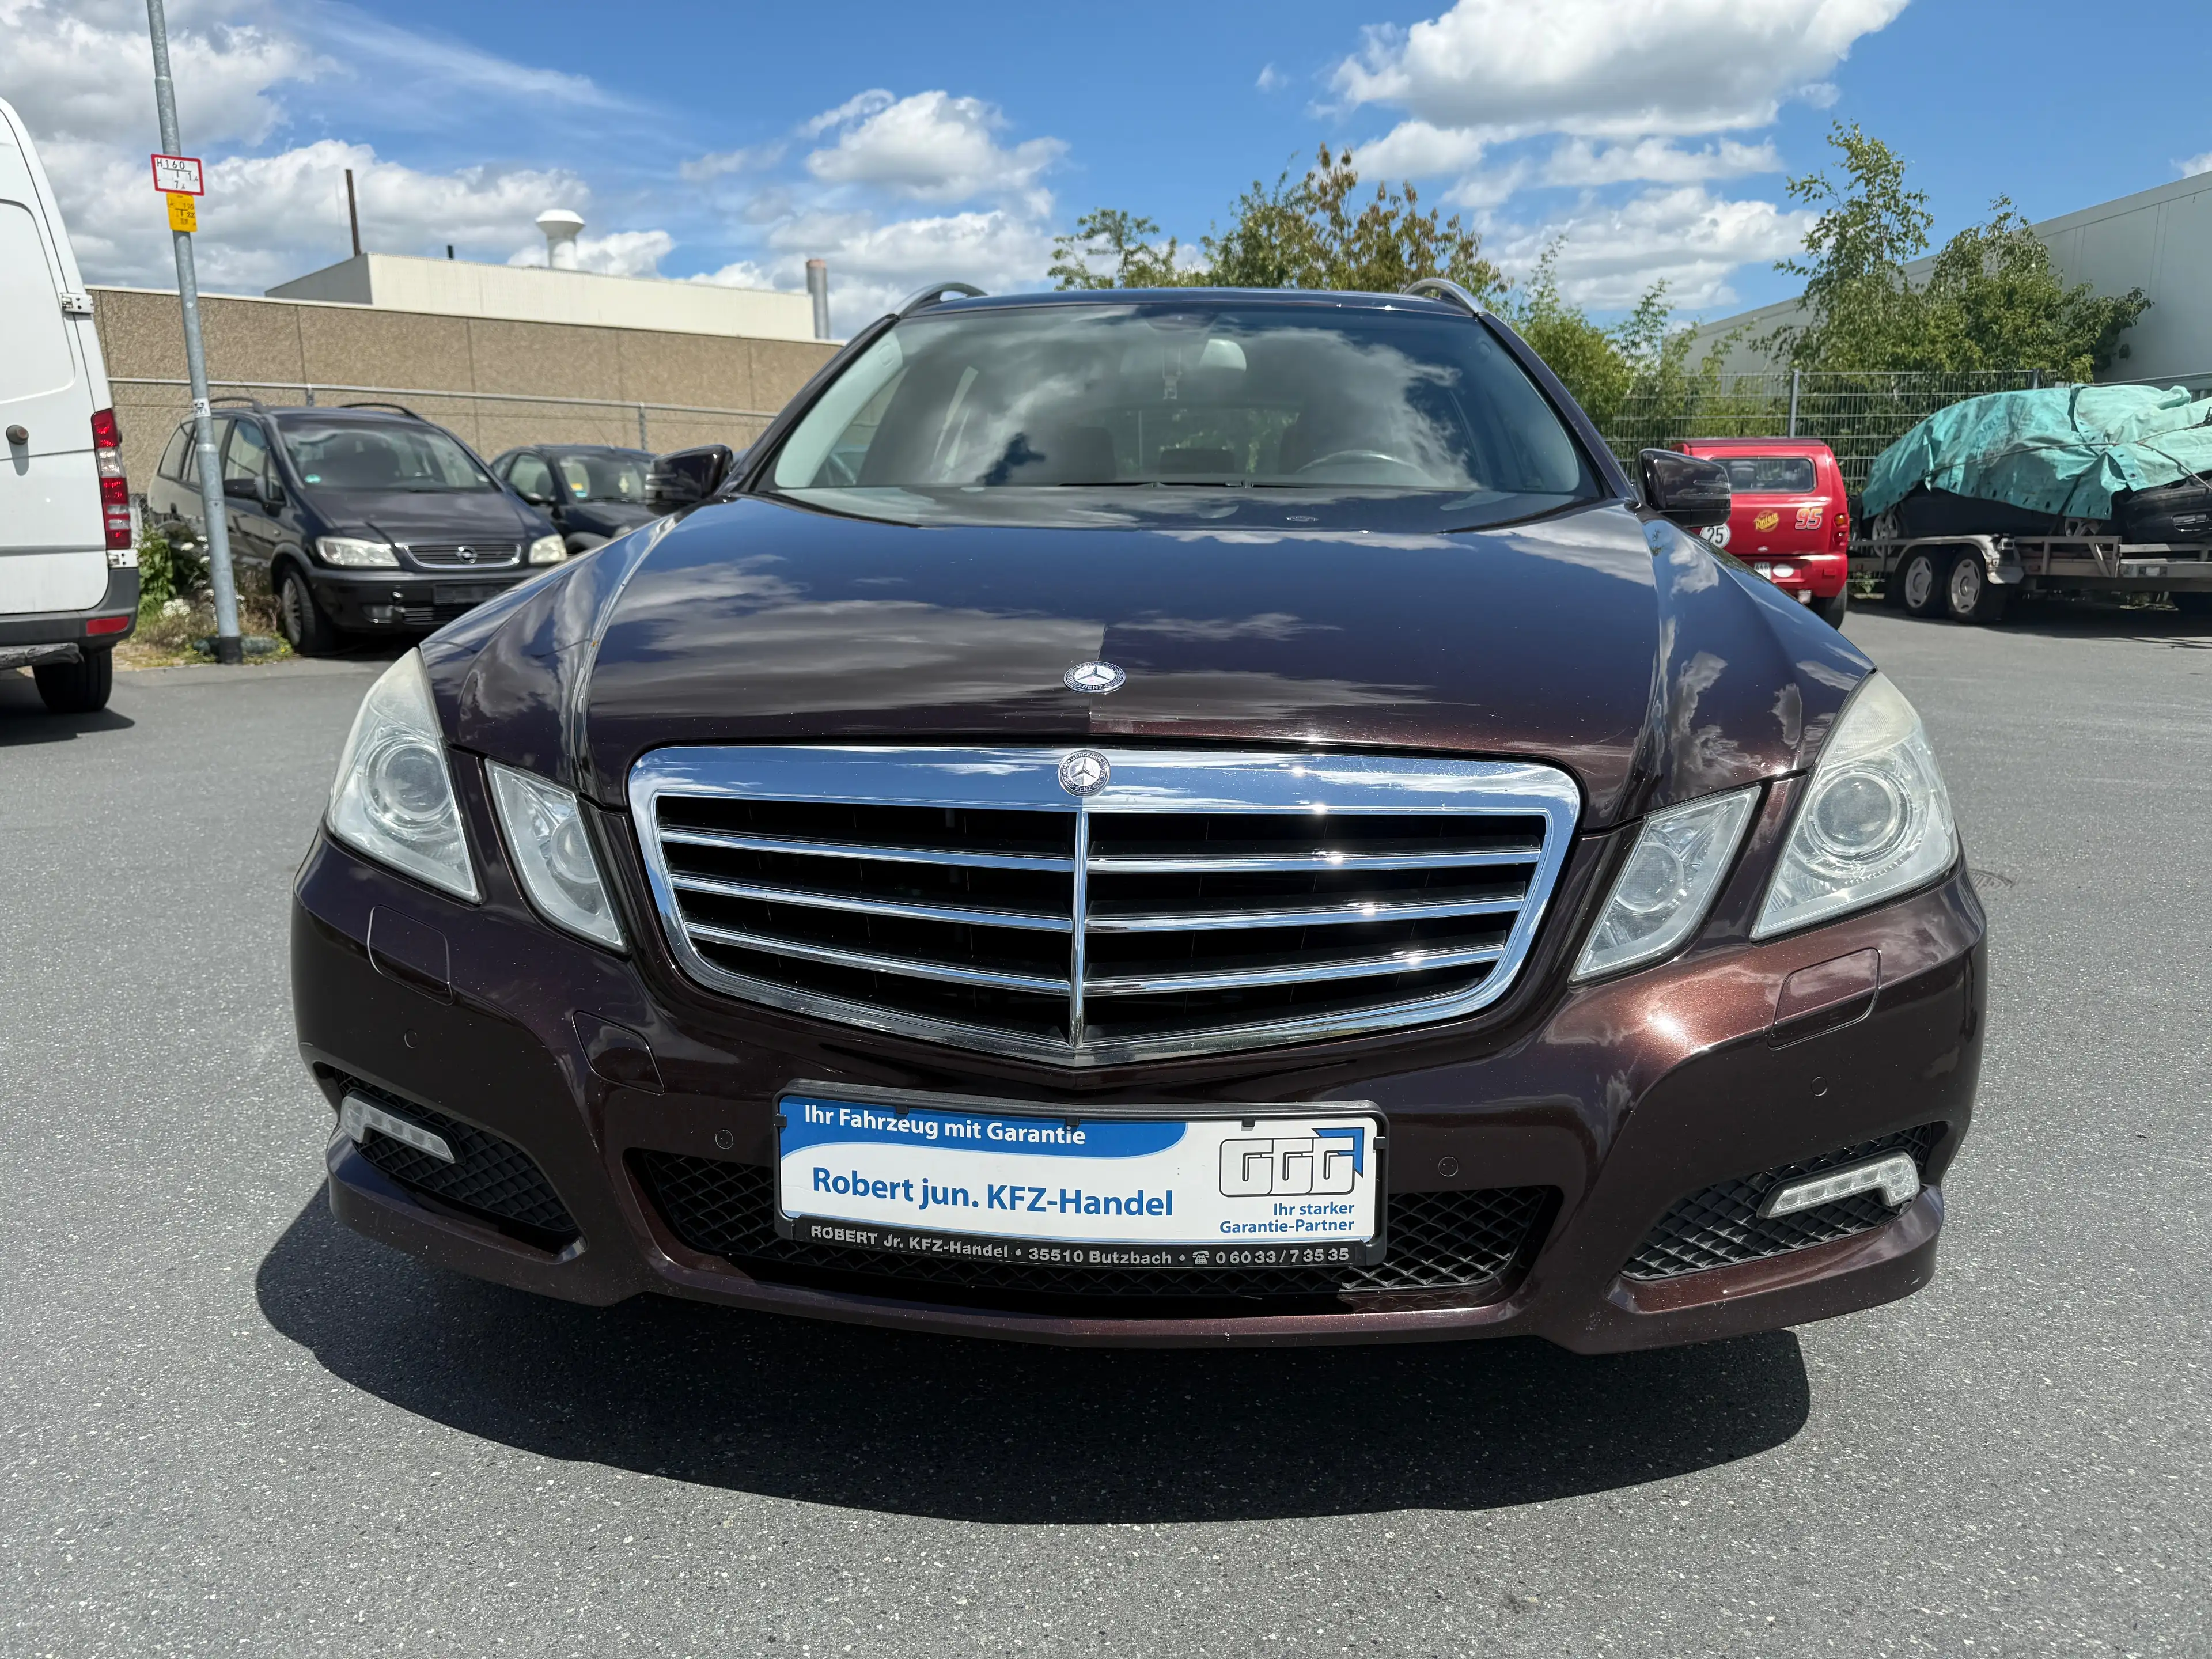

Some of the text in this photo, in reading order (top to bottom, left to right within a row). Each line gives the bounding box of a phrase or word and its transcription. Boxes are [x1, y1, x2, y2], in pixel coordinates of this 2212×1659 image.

[1795, 507, 1823, 529] 95
[1707, 527, 1724, 544] 25
[804, 1104, 1086, 1145] Ihr Fahrzeug mit Garantie
[812, 1166, 1173, 1216] Robert jun. KFZ-Handel
[1273, 1201, 1355, 1216] Ihr starker
[1219, 1219, 1354, 1233] Garantie-Partner
[810, 1225, 878, 1245] ROBERT
[883, 1233, 903, 1249] Jr.
[908, 1236, 1008, 1259] KFZ-Handel
[1028, 1248, 1084, 1263] 35510
[1089, 1249, 1172, 1264] Butzbach
